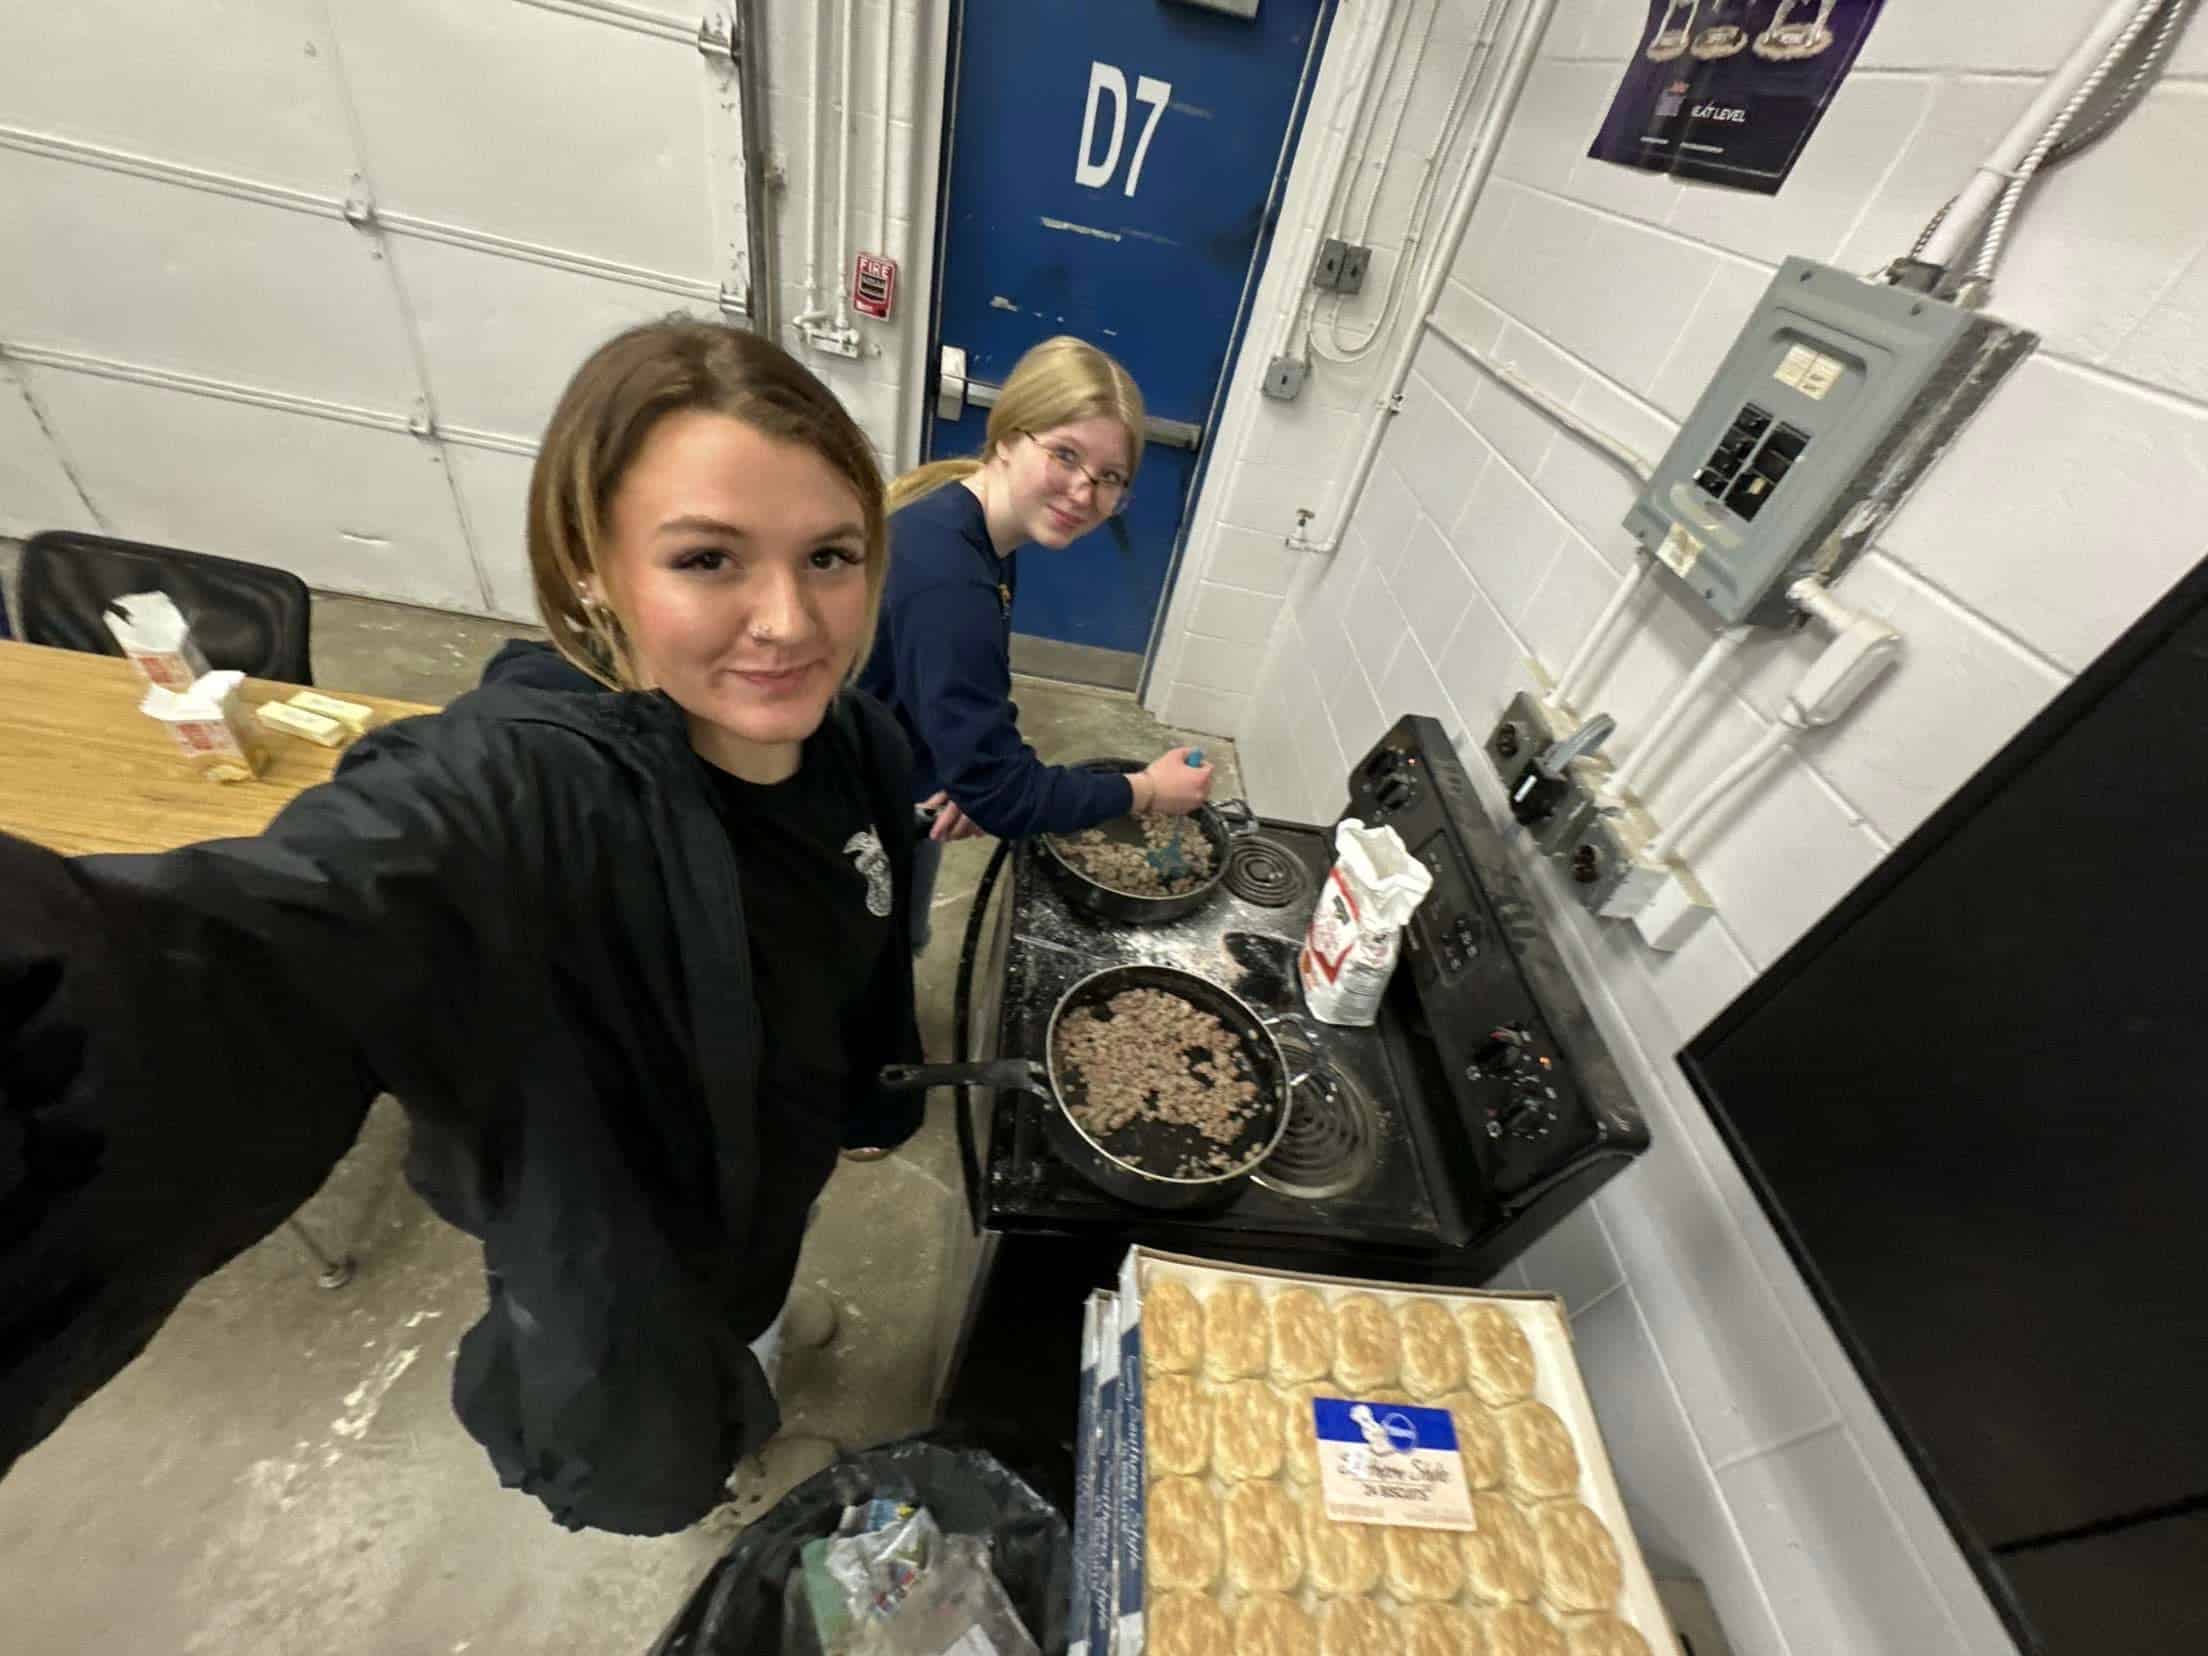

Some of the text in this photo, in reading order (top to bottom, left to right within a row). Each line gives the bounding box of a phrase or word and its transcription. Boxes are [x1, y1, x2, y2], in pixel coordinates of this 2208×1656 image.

[1713, 108, 1746, 122] LEVEL
[1075, 61, 1172, 197] D7
[860, 259, 890, 278] FIRE
